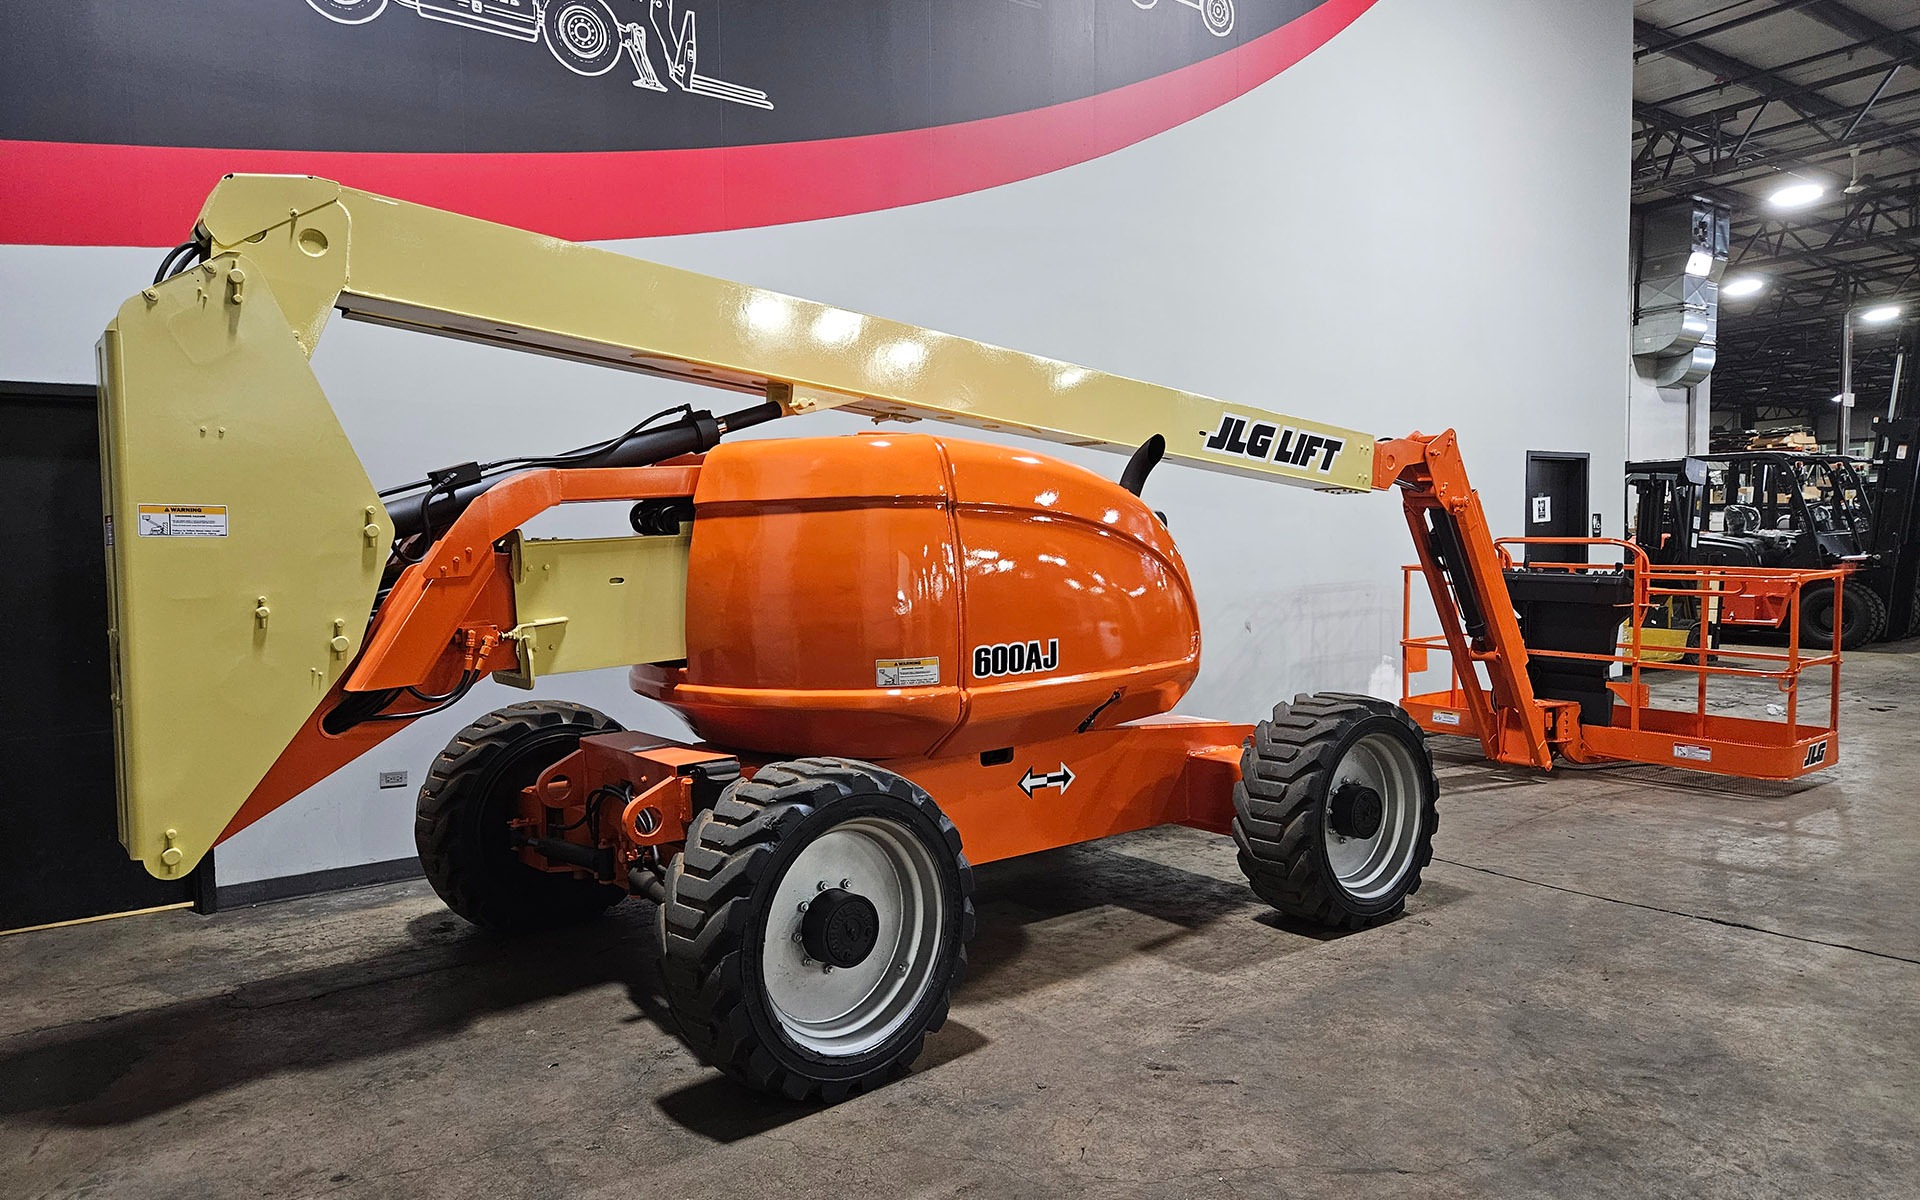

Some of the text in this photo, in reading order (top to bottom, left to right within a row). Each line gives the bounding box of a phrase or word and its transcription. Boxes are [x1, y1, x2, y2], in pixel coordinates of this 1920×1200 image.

[1205, 415, 1344, 472] JLG LIFT
[973, 639, 1058, 677] 600AJ
[1803, 741, 1827, 767] JLG
